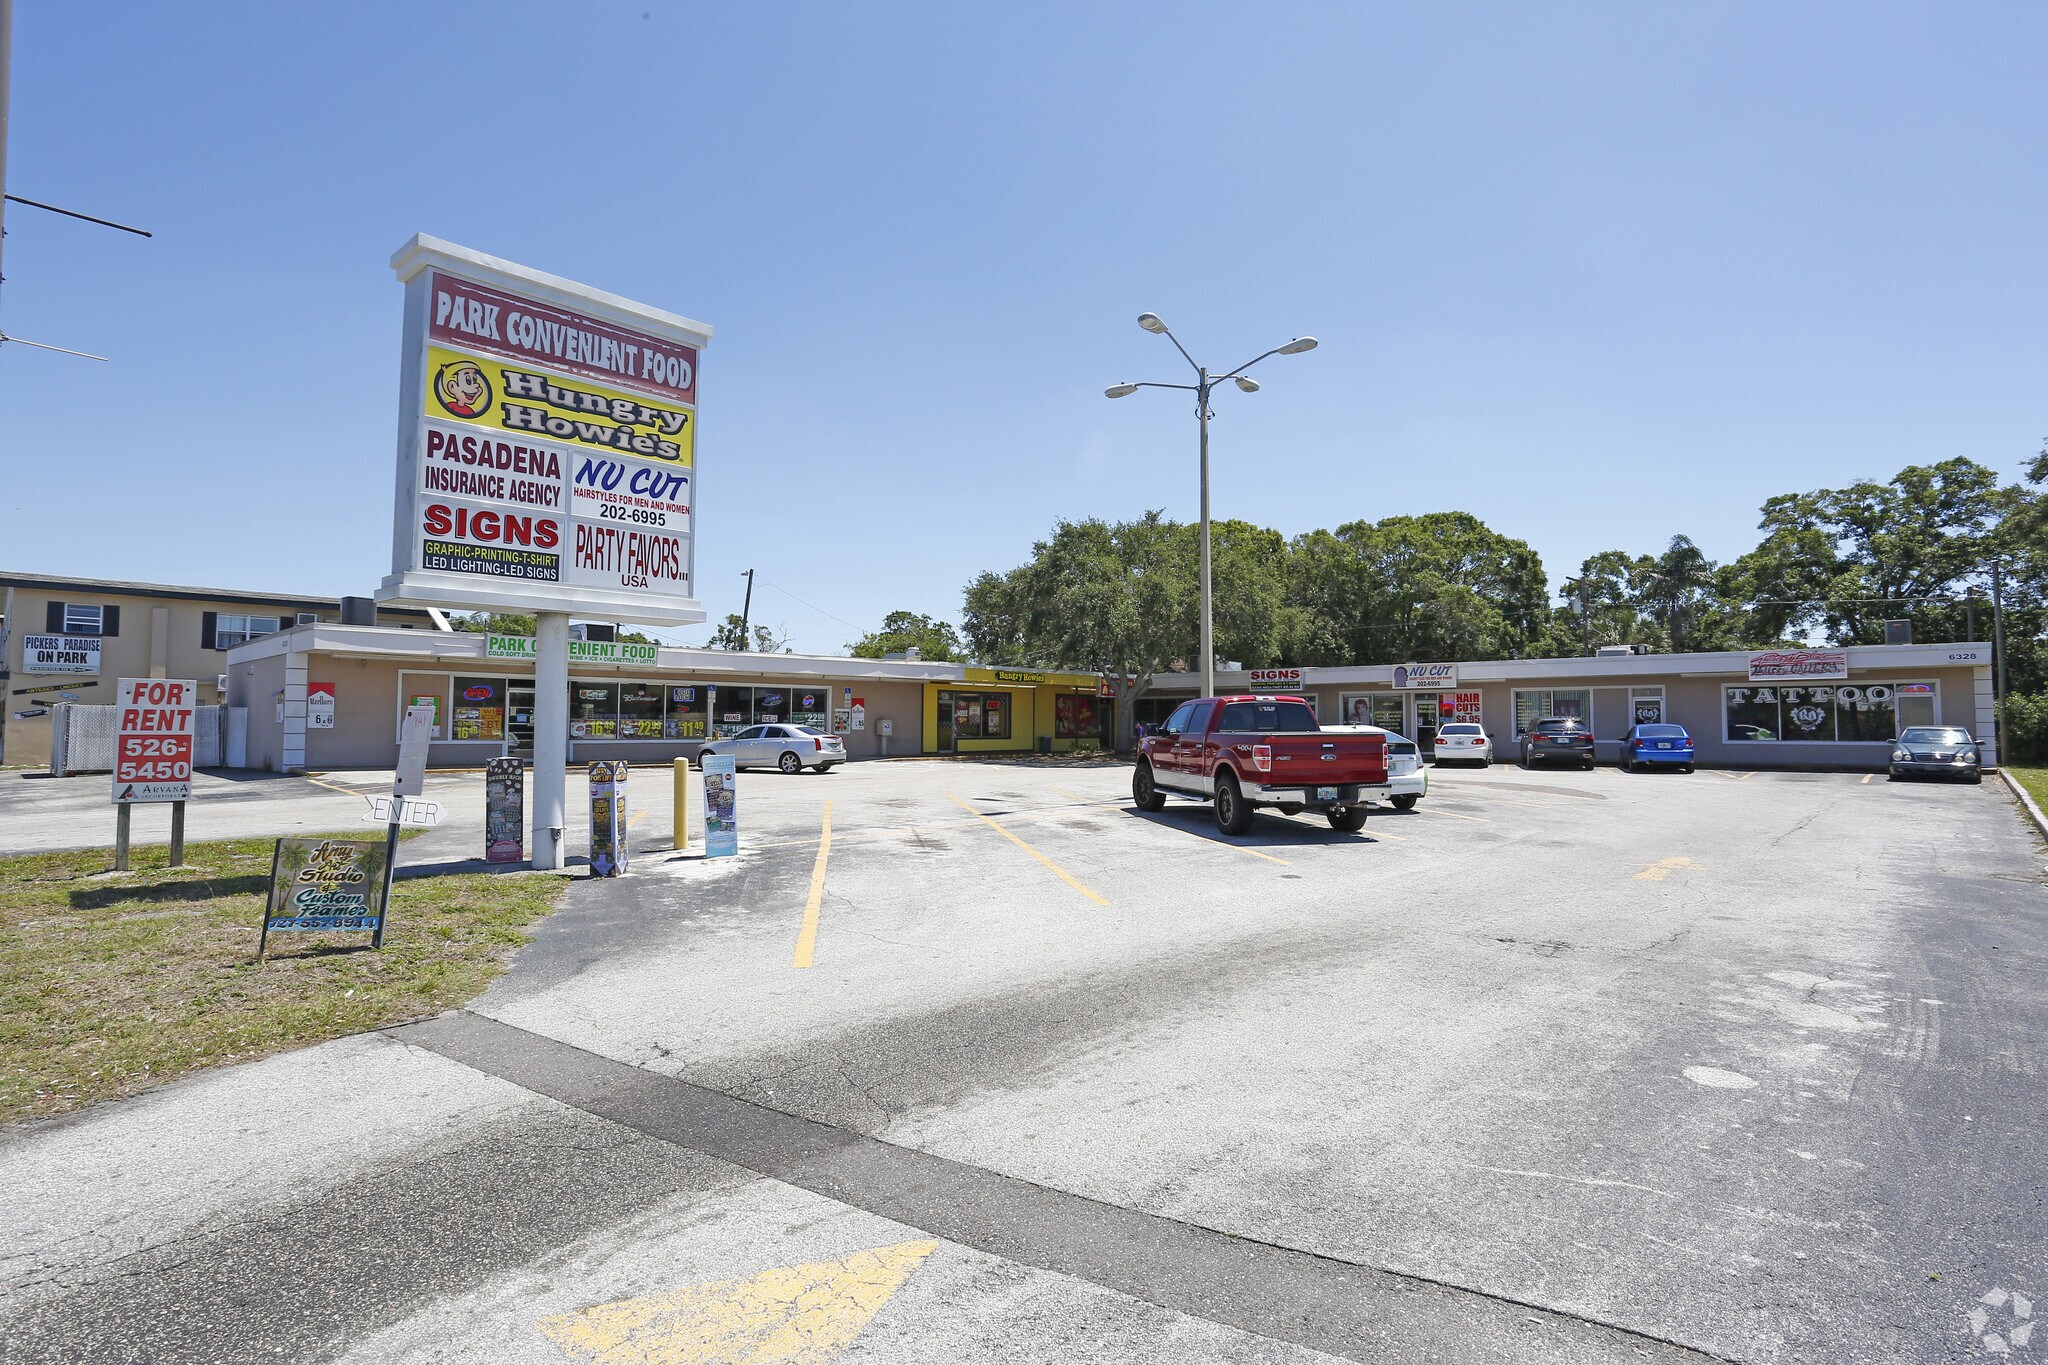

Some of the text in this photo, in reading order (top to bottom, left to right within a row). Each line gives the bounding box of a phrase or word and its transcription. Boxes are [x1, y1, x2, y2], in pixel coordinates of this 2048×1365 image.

[436, 290, 692, 390] PARK CONVENIENT FOOD
[501, 369, 688, 435] Hungry
[501, 402, 680, 461] Howie's
[427, 430, 561, 479] PASADENA
[425, 466, 561, 507] INSURANCE AGENCY
[575, 458, 689, 501] NU CUT
[573, 487, 690, 515] HAIRSTYLES FOR MEN AND WOMEN
[600, 504, 666, 526] 202-6995
[423, 504, 559, 549] SIGNS
[425, 541, 557, 567] GRAPHIC-PRINTING-T-SHIRT
[575, 524, 625, 573] PARTY
[425, 556, 557, 580] LED LIGHTING-LED SIGNS
[621, 574, 648, 588] USA
[25, 636, 100, 651] PICKERS PARADISE
[489, 636, 527, 652] PARK
[622, 645, 656, 659] FOOD
[37, 650, 88, 664] ON PARK
[999, 671, 1023, 681] Hungry
[1250, 669, 1300, 680] SIGNS
[1409, 665, 1453, 676] NU CUT
[132, 682, 184, 705] FOR
[465, 687, 490, 699] OPEN
[1456, 693, 1480, 703] HAIR
[1727, 686, 1894, 704] TATTOO
[1456, 703, 1480, 712] CUTS
[121, 709, 192, 731] RENT
[1456, 715, 1480, 723] $6.95
[125, 738, 187, 757] 526-
[119, 761, 190, 780] 5450
[374, 798, 438, 824] ENTER
[299, 866, 365, 883] Studio
[295, 888, 363, 905] Custom
[298, 903, 369, 918] Frames
